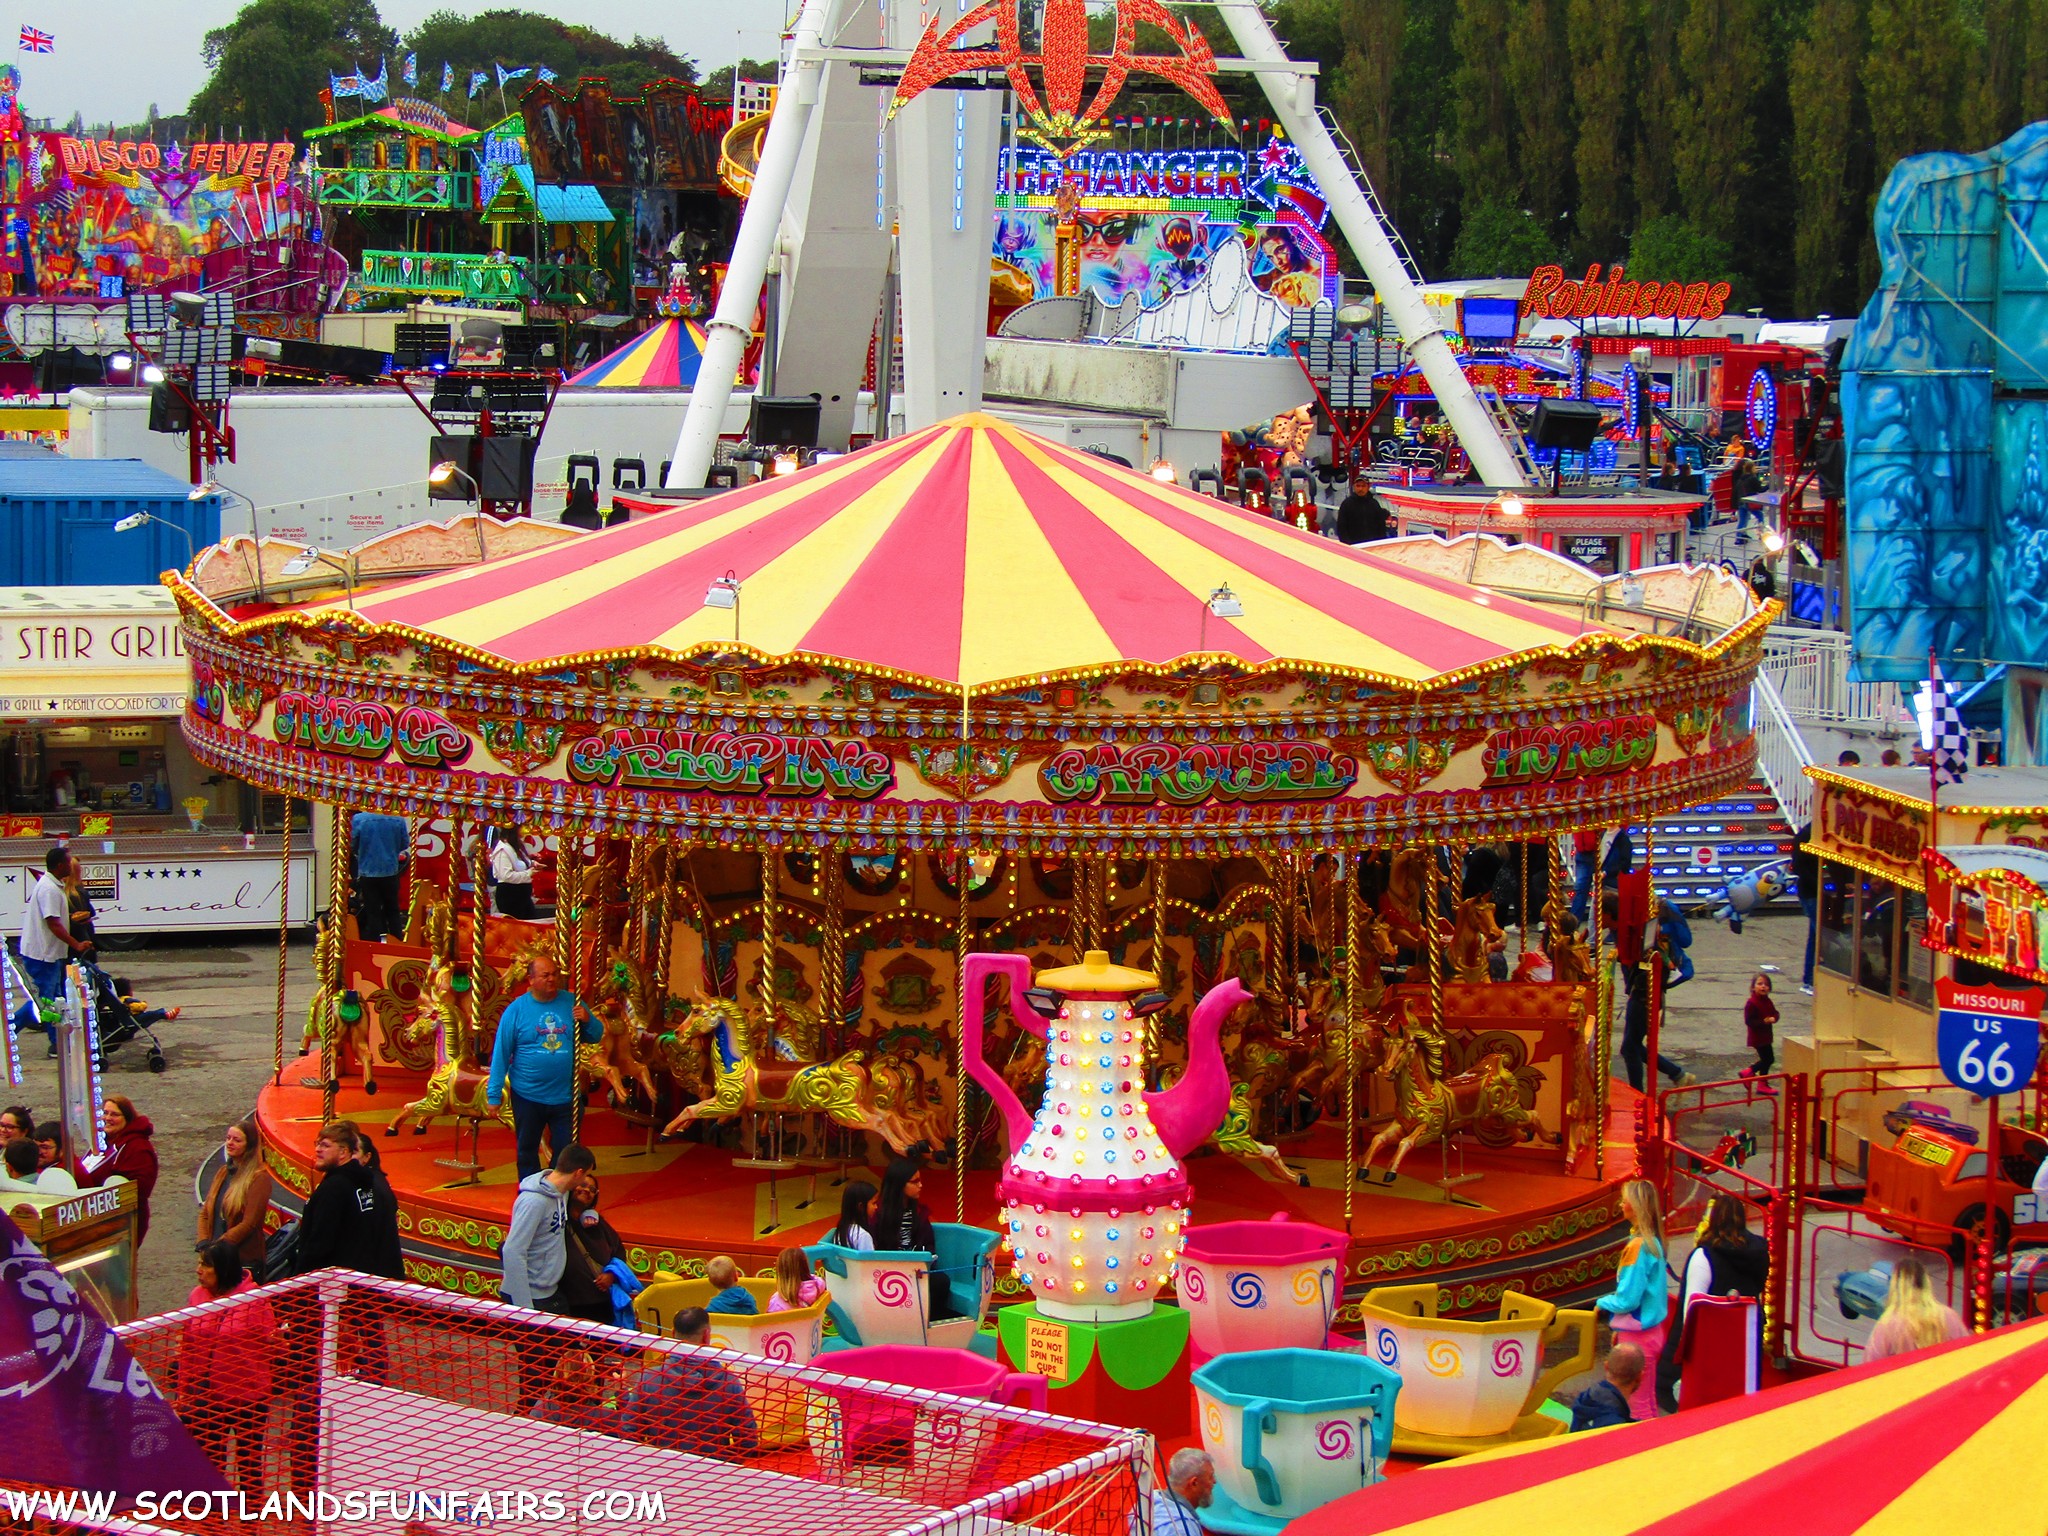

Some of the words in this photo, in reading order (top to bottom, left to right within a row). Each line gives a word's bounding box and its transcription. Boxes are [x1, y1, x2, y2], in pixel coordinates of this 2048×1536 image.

[59, 137, 160, 173] DISCO
[189, 142, 295, 180] FEVER
[996, 148, 1247, 199] IFFHANGER
[1521, 263, 1731, 320] Robinsons
[1576, 538, 1602, 546] PLEASE
[18, 626, 92, 659] STAR
[111, 626, 185, 657] GRIL
[15, 699, 41, 710] GRILL
[63, 698, 95, 710] FRESHLY
[98, 698, 143, 710] COOKED
[146, 697, 167, 709] FOR
[170, 697, 186, 709] YO
[393, 705, 469, 762] OF
[1482, 713, 1658, 782] HORSES
[567, 727, 894, 793] GALLOPING
[1042, 741, 1359, 800] CAROUSEL
[92, 865, 114, 878] GRILL
[141, 881, 281, 912] meal!
[1953, 992, 2025, 1012] MISSOURI
[1973, 1018, 2003, 1034] US
[1958, 1038, 2015, 1088] 66
[58, 1200, 83, 1227] PAY
[87, 1188, 121, 1217] HERE
[1031, 1327, 1063, 1337] PLEASE
[1031, 1338, 1043, 1348] DO
[1046, 1342, 1062, 1352] NOT
[88, 1332, 164, 1399] Le
[1030, 1350, 1047, 1360] SPIN
[1050, 1354, 1063, 1364] THE
[1037, 1362, 1057, 1373] CUPS
